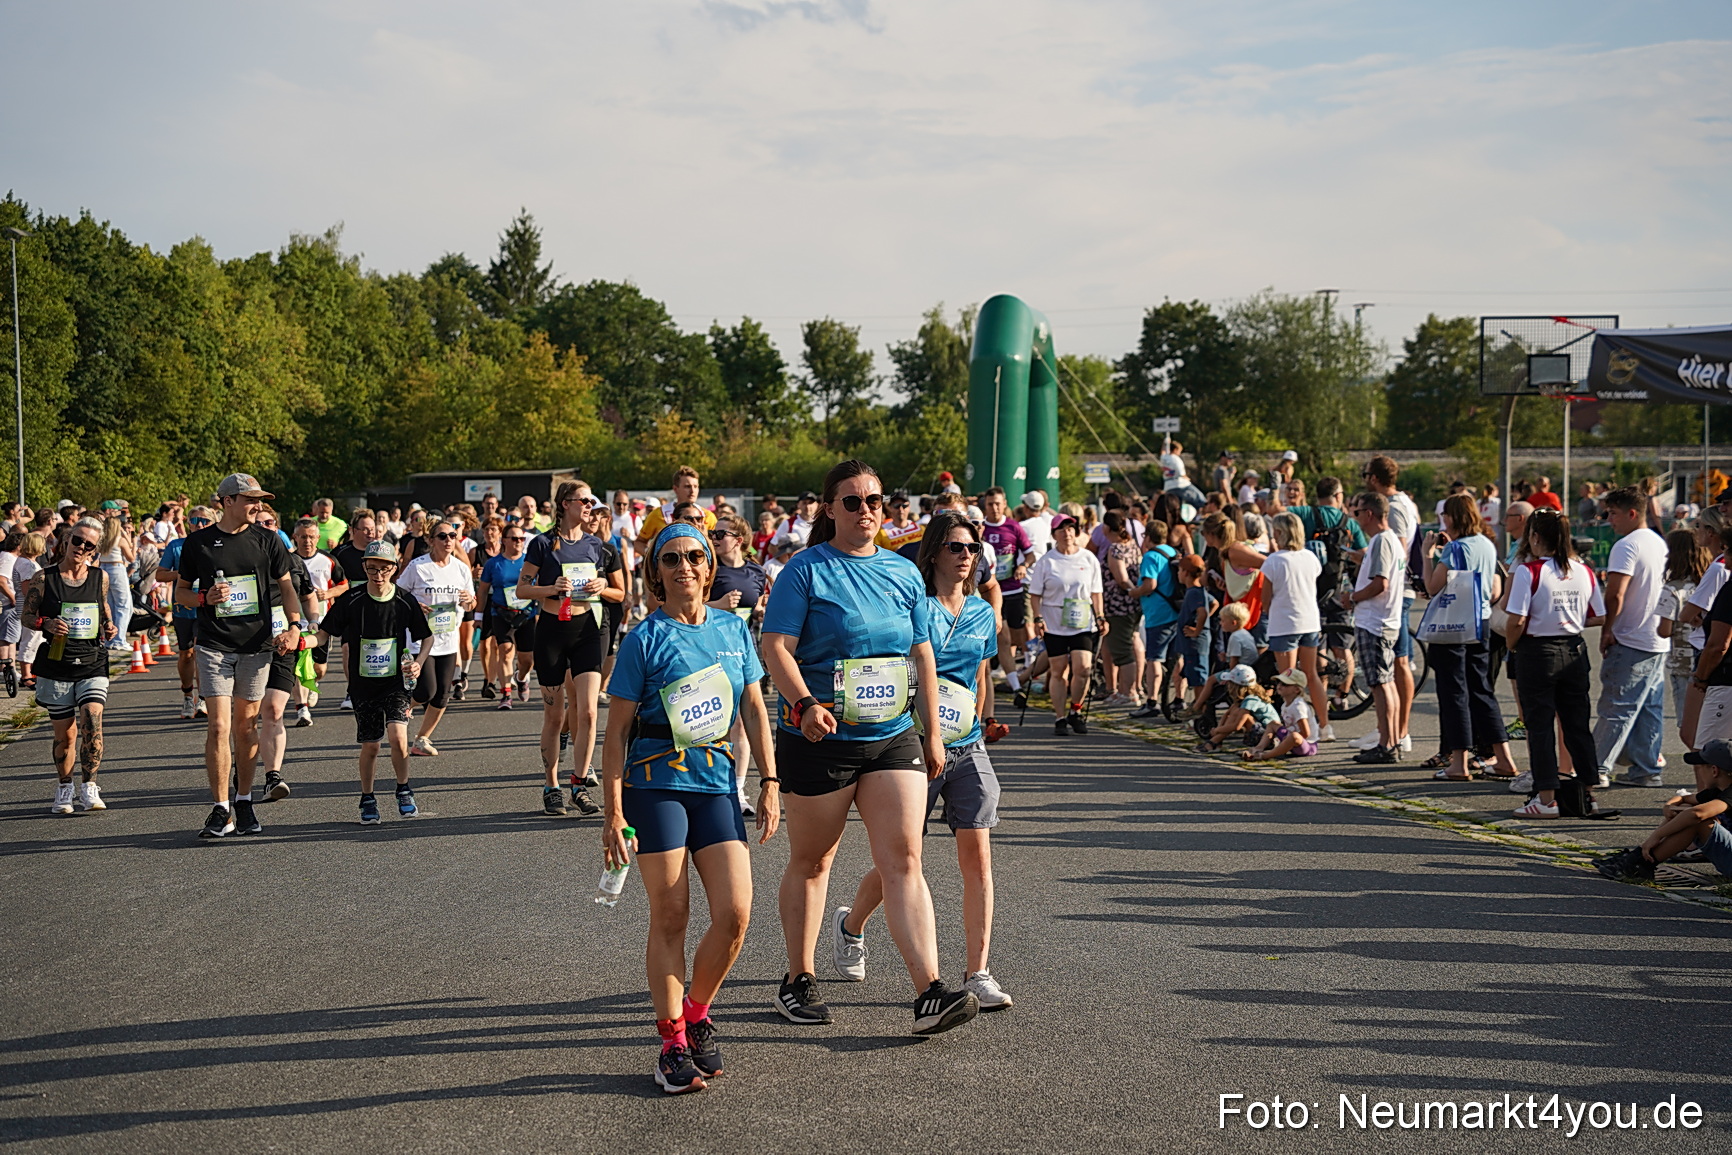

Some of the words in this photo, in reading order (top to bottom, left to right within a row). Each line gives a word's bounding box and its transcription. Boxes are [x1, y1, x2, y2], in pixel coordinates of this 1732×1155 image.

[1677, 353, 1725, 389] Hier
[571, 579, 591, 587] 220
[229, 592, 248, 602] 301
[434, 615, 451, 623] 1558
[272, 620, 284, 629] 08
[1446, 623, 1466, 631] BANK
[365, 655, 391, 664] 2294
[855, 684, 896, 700] 2833
[857, 701, 879, 709] Theresa
[680, 696, 723, 725] 2828
[938, 705, 961, 723] 831
[689, 720, 710, 732] Andrea
[710, 713, 724, 723] Hierl
[946, 723, 962, 734] Liebig
